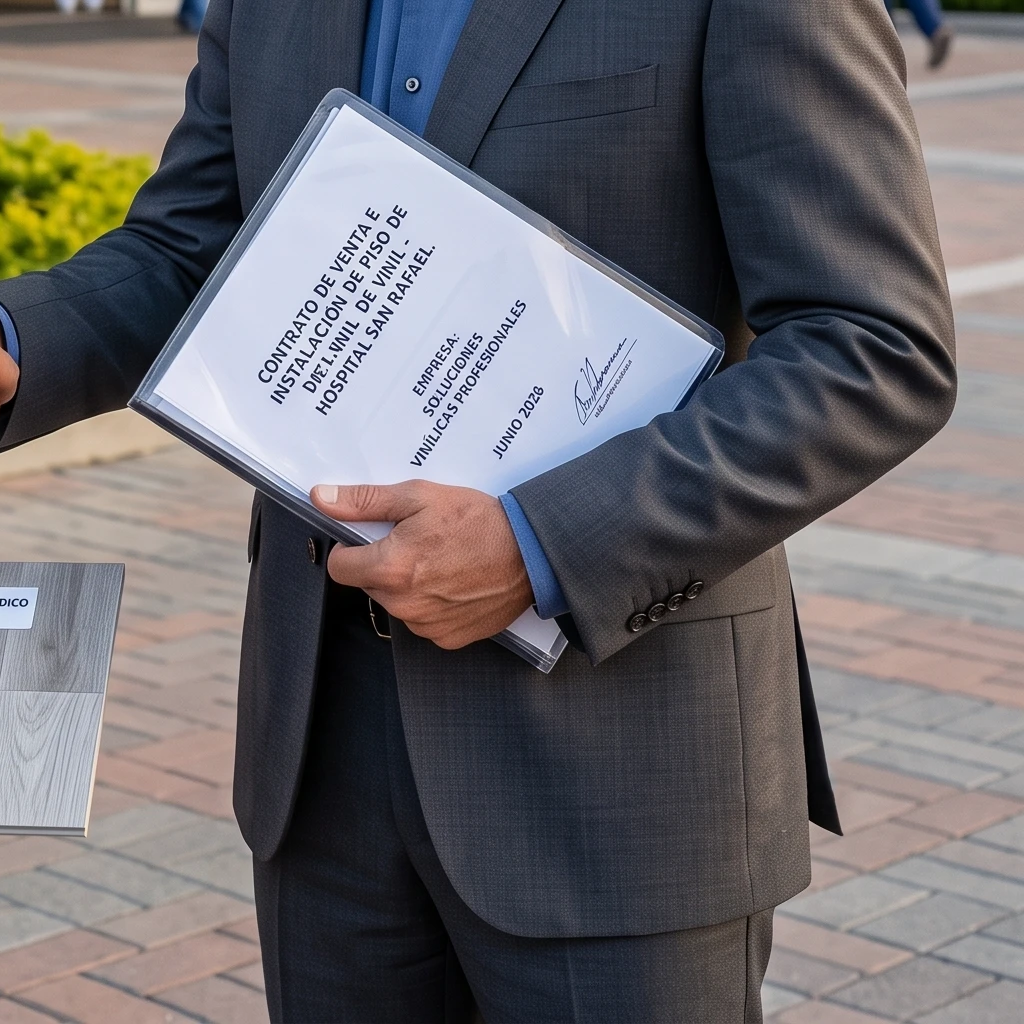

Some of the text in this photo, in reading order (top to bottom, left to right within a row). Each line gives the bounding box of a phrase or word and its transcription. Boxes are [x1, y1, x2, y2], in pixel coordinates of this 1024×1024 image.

[257, 206, 381, 384] CONTRATO DE VENTA E
[270, 204, 408, 405] INSTALACIÓN DE PISO DE
[354, 288, 378, 314] DE
[371, 249, 407, 287] VINIL
[315, 341, 373, 416] HOSPITAL
[365, 304, 394, 340] SAN
[409, 299, 527, 467] VINÍLICAS PROFESIONALES
[412, 333, 460, 397] EMPRESA:
[492, 418, 523, 460] JUNIO
